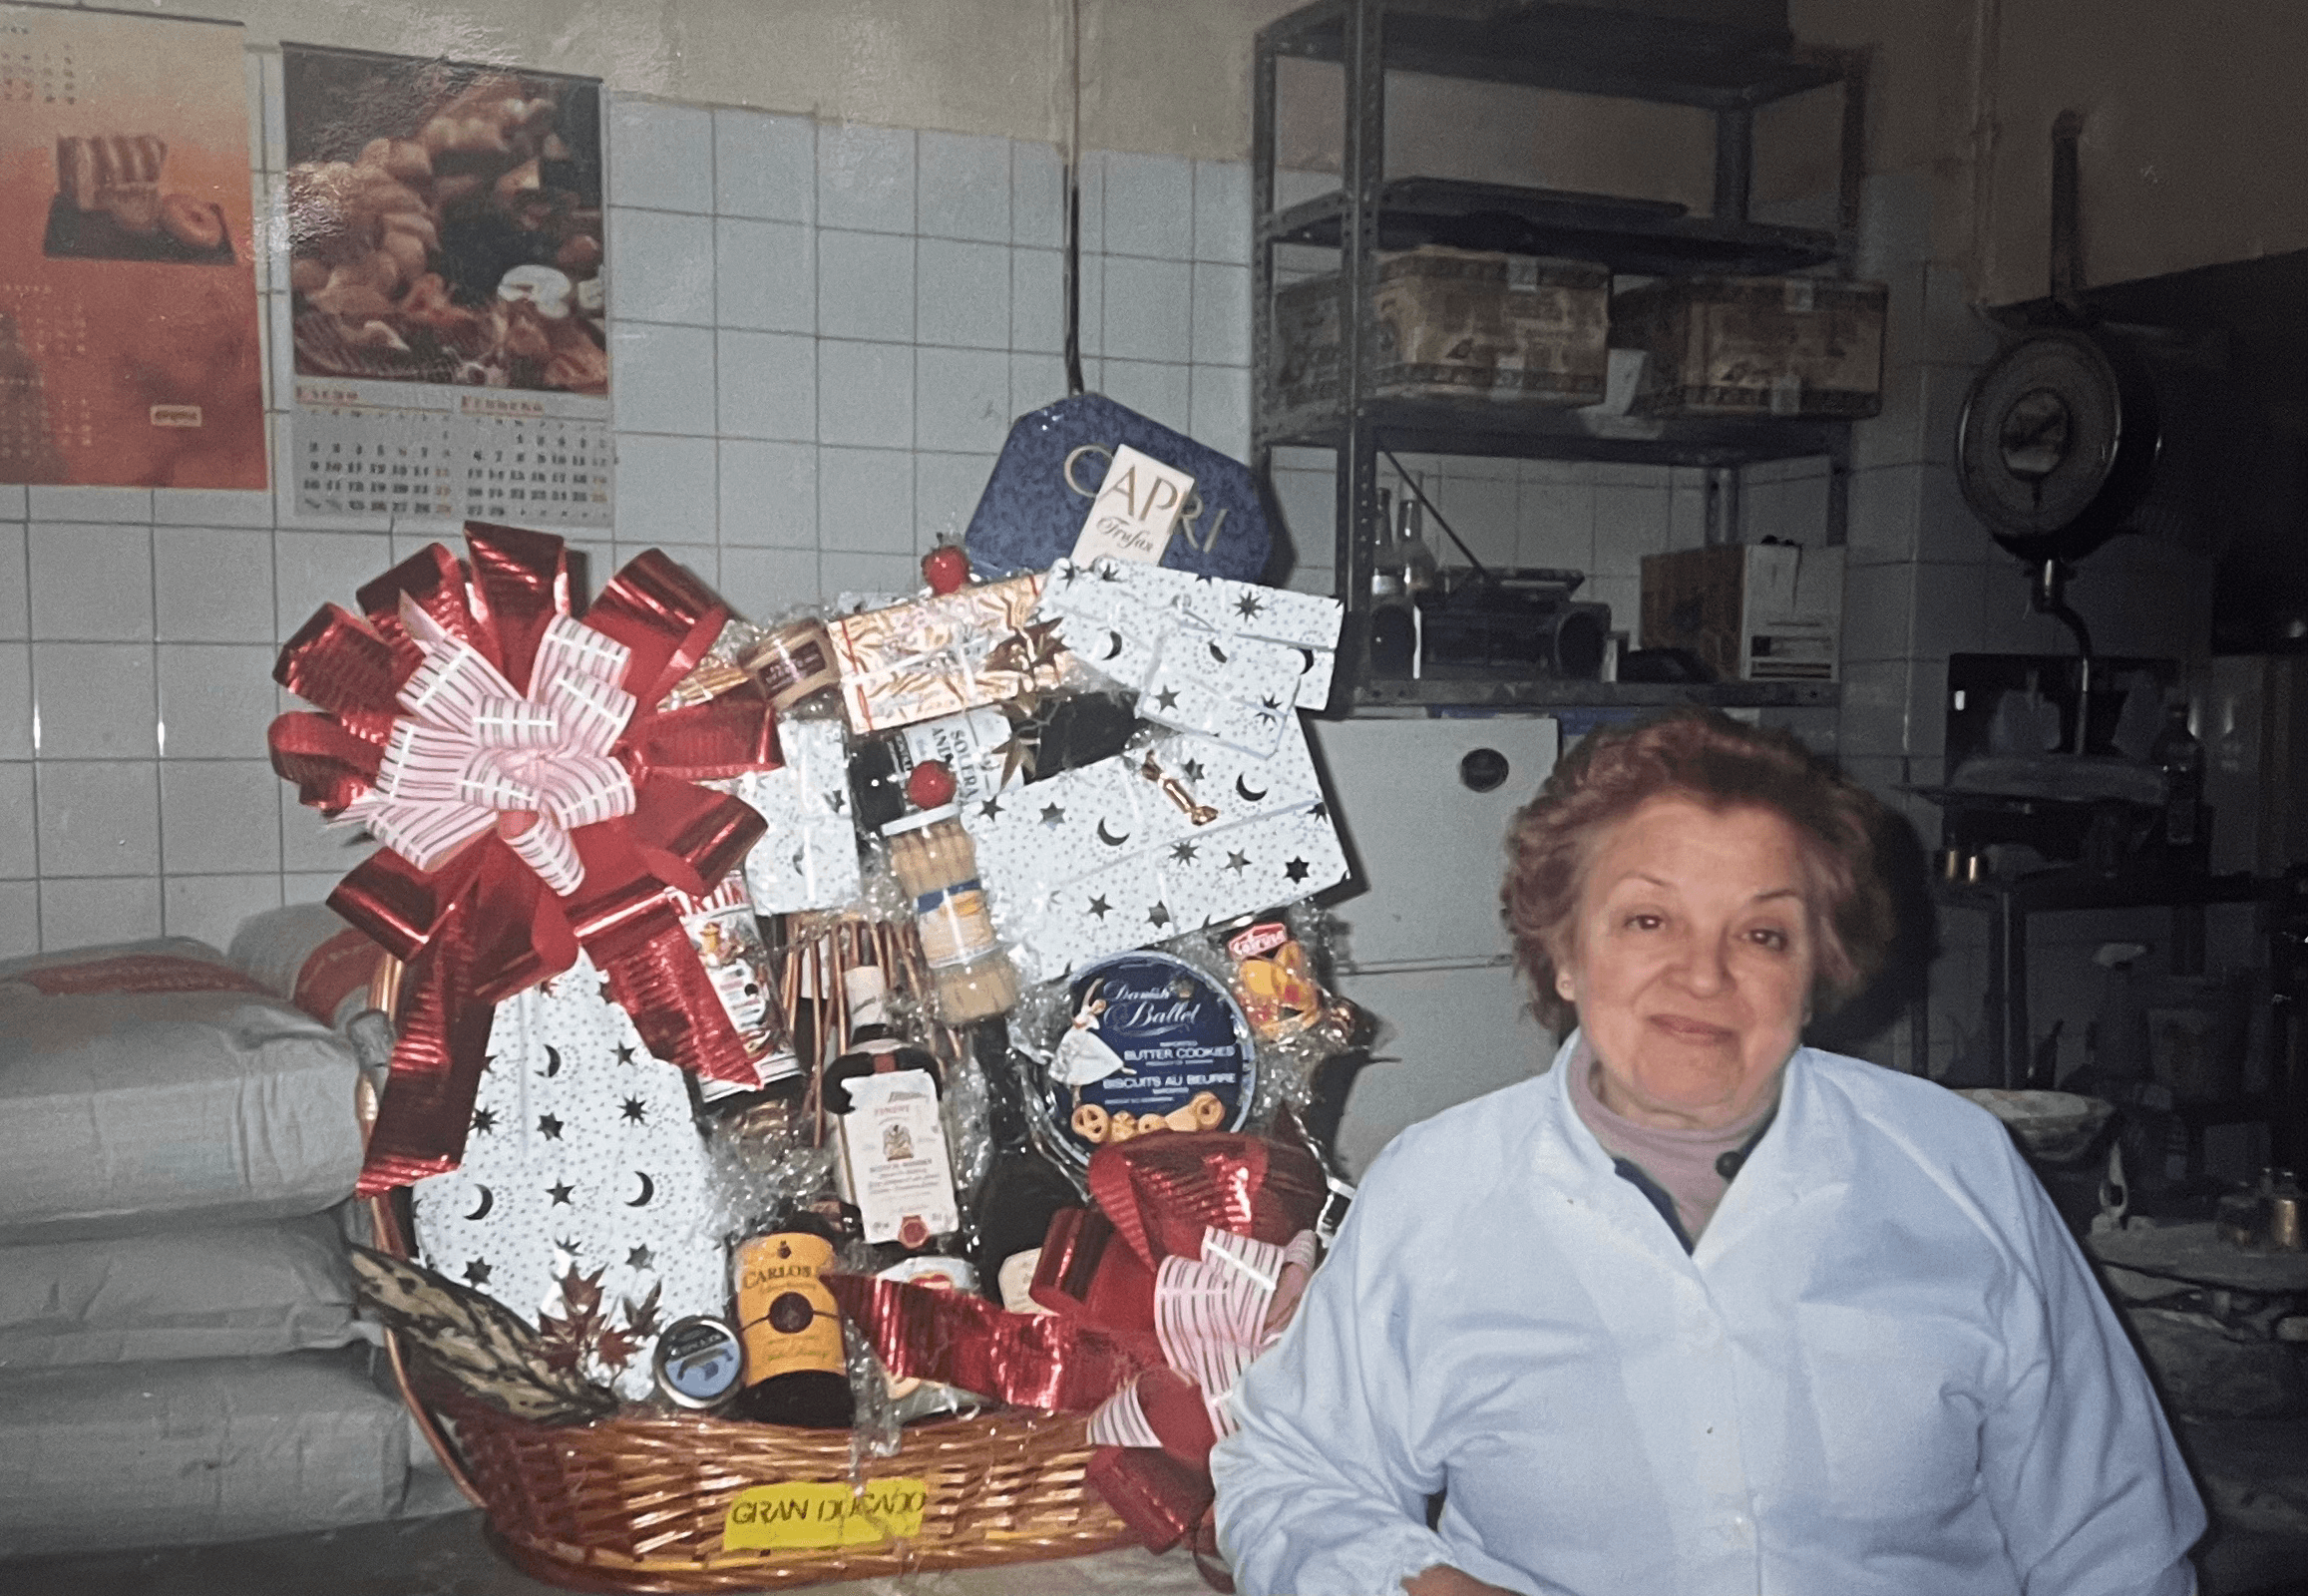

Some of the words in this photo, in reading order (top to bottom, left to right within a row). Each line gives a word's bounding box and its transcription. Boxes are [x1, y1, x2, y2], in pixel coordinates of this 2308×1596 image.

[1063, 444, 1229, 554] CAPRI
[1124, 1048, 1174, 1061] BUTTER
[1164, 1074, 1184, 1086] AU
[742, 1265, 812, 1289] CARLOS
[731, 1498, 810, 1525] GRAN
